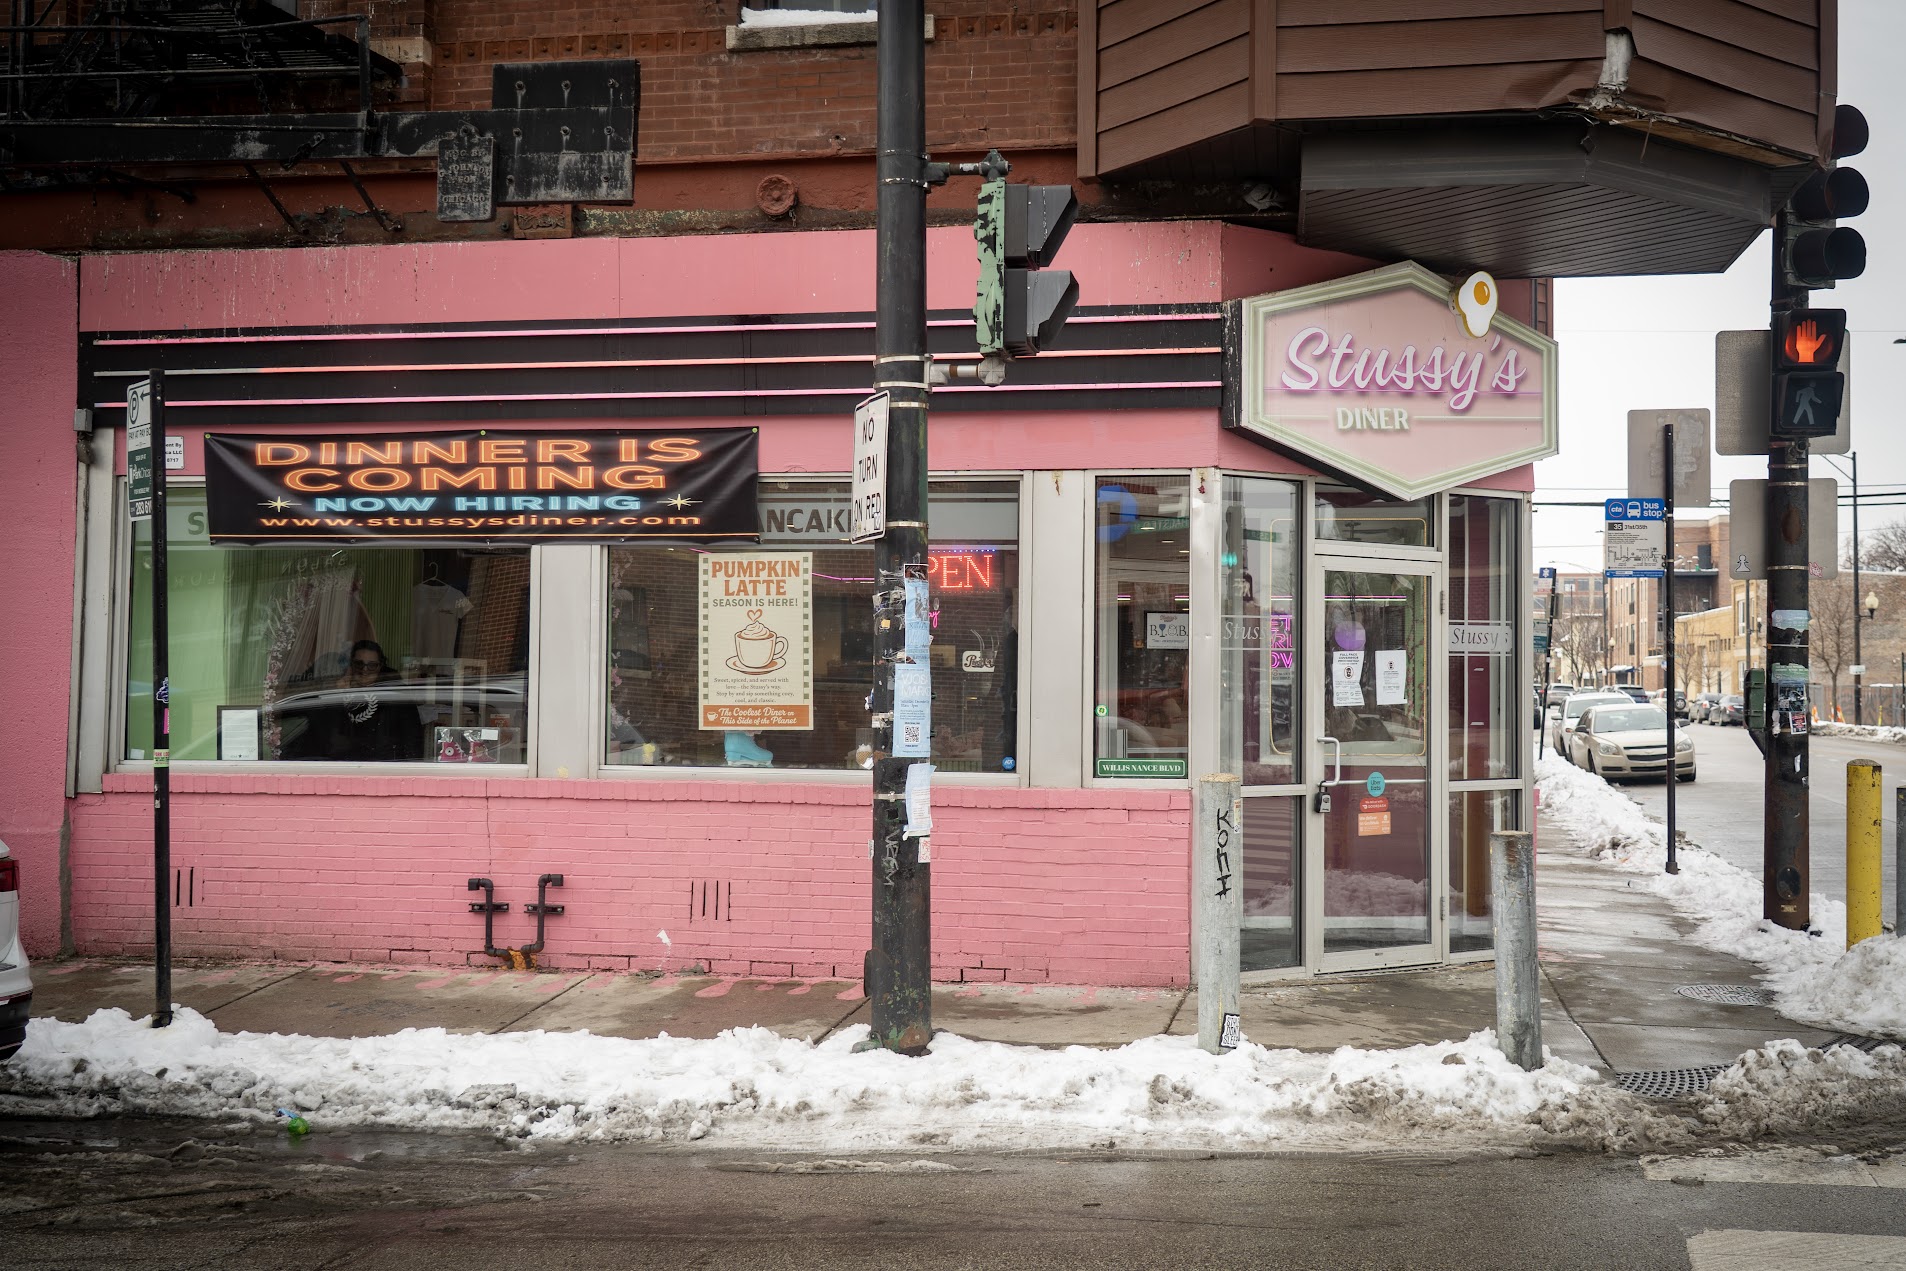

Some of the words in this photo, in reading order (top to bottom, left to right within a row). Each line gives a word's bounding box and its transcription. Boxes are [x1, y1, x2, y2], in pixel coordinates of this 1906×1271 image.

[1281, 327, 1526, 410] Stussy's
[1336, 407, 1410, 430] DINER
[862, 416, 875, 445] NO
[255, 438, 592, 466] DINNER
[619, 438, 702, 463] IS
[858, 454, 878, 484] TURN
[284, 465, 666, 492] COMING
[136, 502, 144, 515] 283
[315, 497, 437, 512] NOW
[455, 495, 642, 511] HIRING
[854, 498, 862, 522] ON
[866, 492, 881, 520] RED
[260, 514, 701, 528] www.stussysdiner.com
[1643, 510, 1662, 518] stop
[712, 560, 800, 578] PUMPKIN
[928, 554, 992, 588] PEN
[724, 580, 786, 596] LATTE
[712, 599, 752, 607] SEASON
[768, 598, 798, 606] HERE!
[718, 708, 732, 716] The
[733, 707, 762, 716] Coolest
[763, 707, 786, 716] Diner
[720, 716, 735, 724] This
[737, 716, 752, 724] Side
